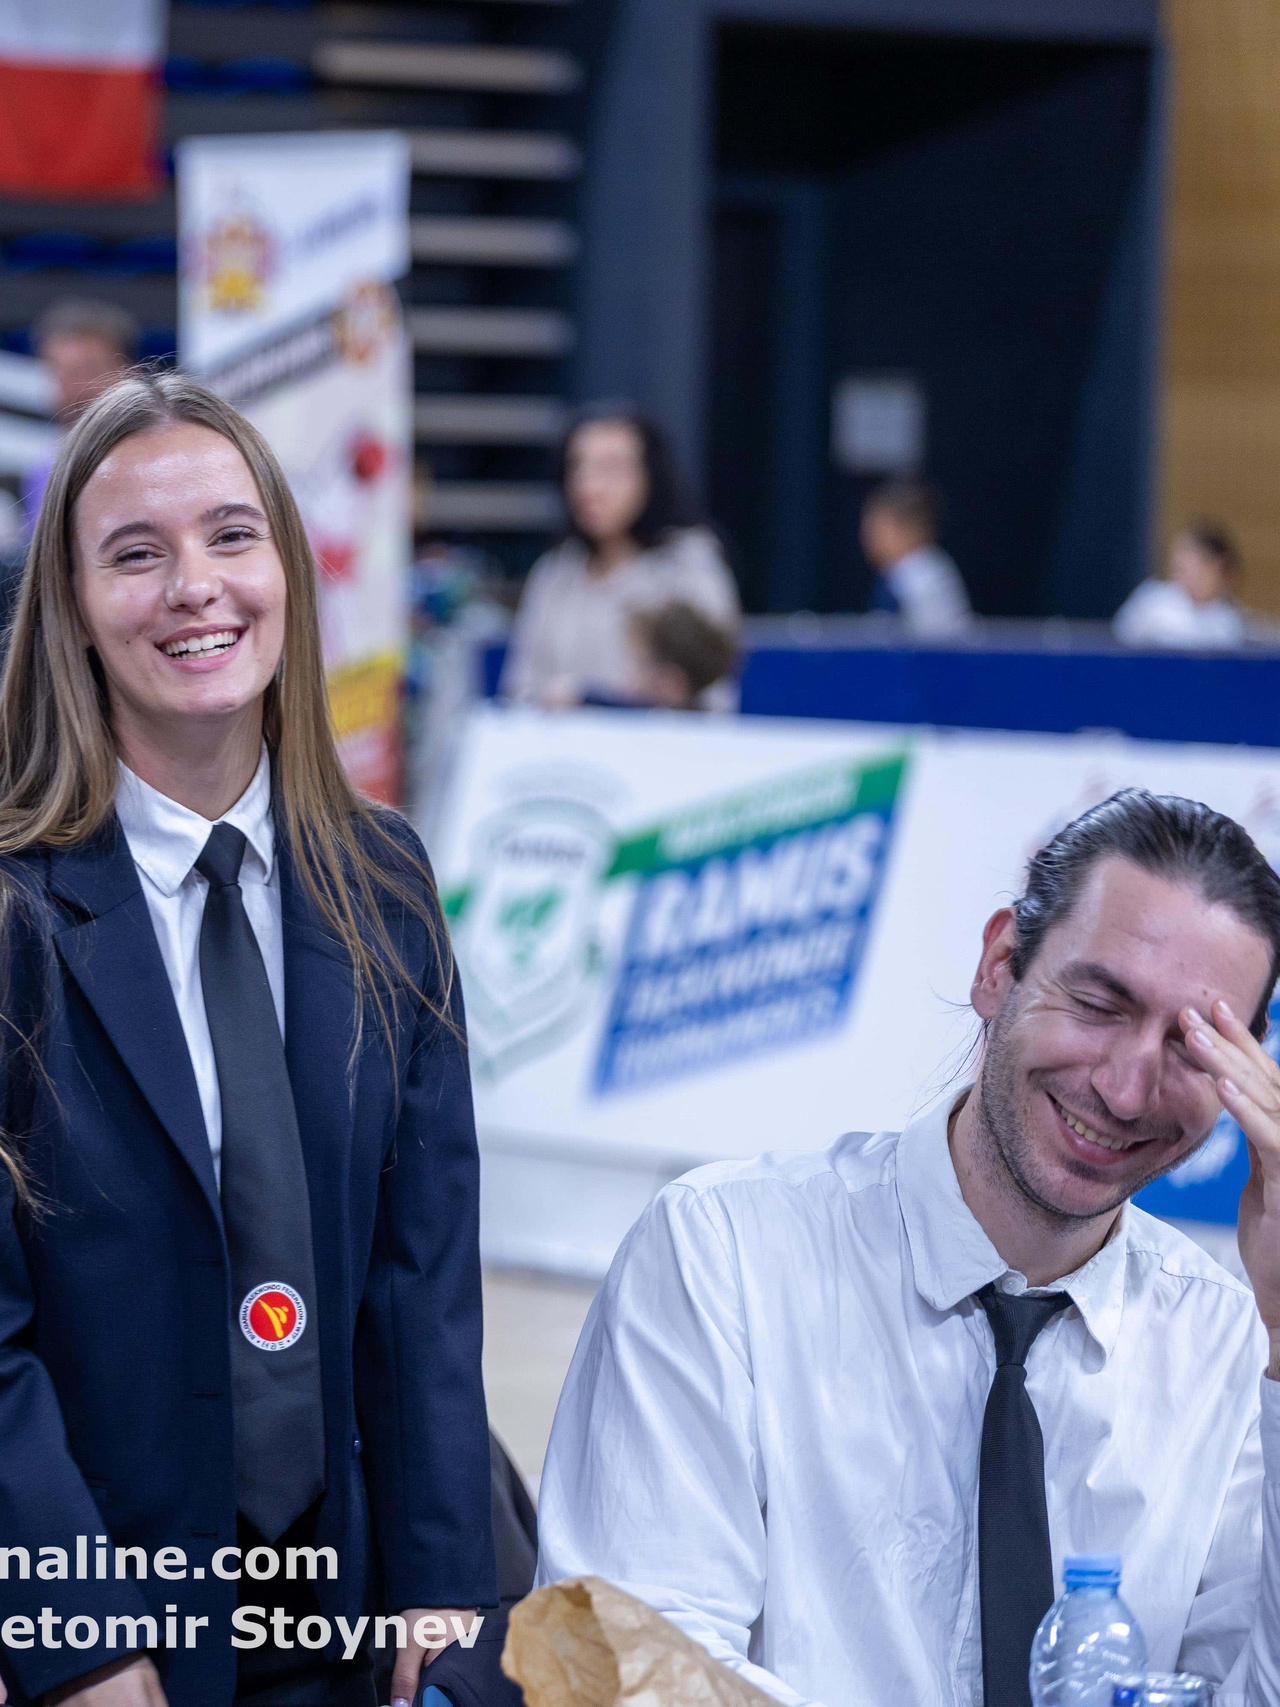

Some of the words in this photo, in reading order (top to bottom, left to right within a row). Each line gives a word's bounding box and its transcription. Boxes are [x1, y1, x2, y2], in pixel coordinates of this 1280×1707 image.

[246, 1284, 281, 1304] TAEKWONDO
[282, 1286, 304, 1320] FEDERATION
[242, 1305, 256, 1341] BULGARIAN
